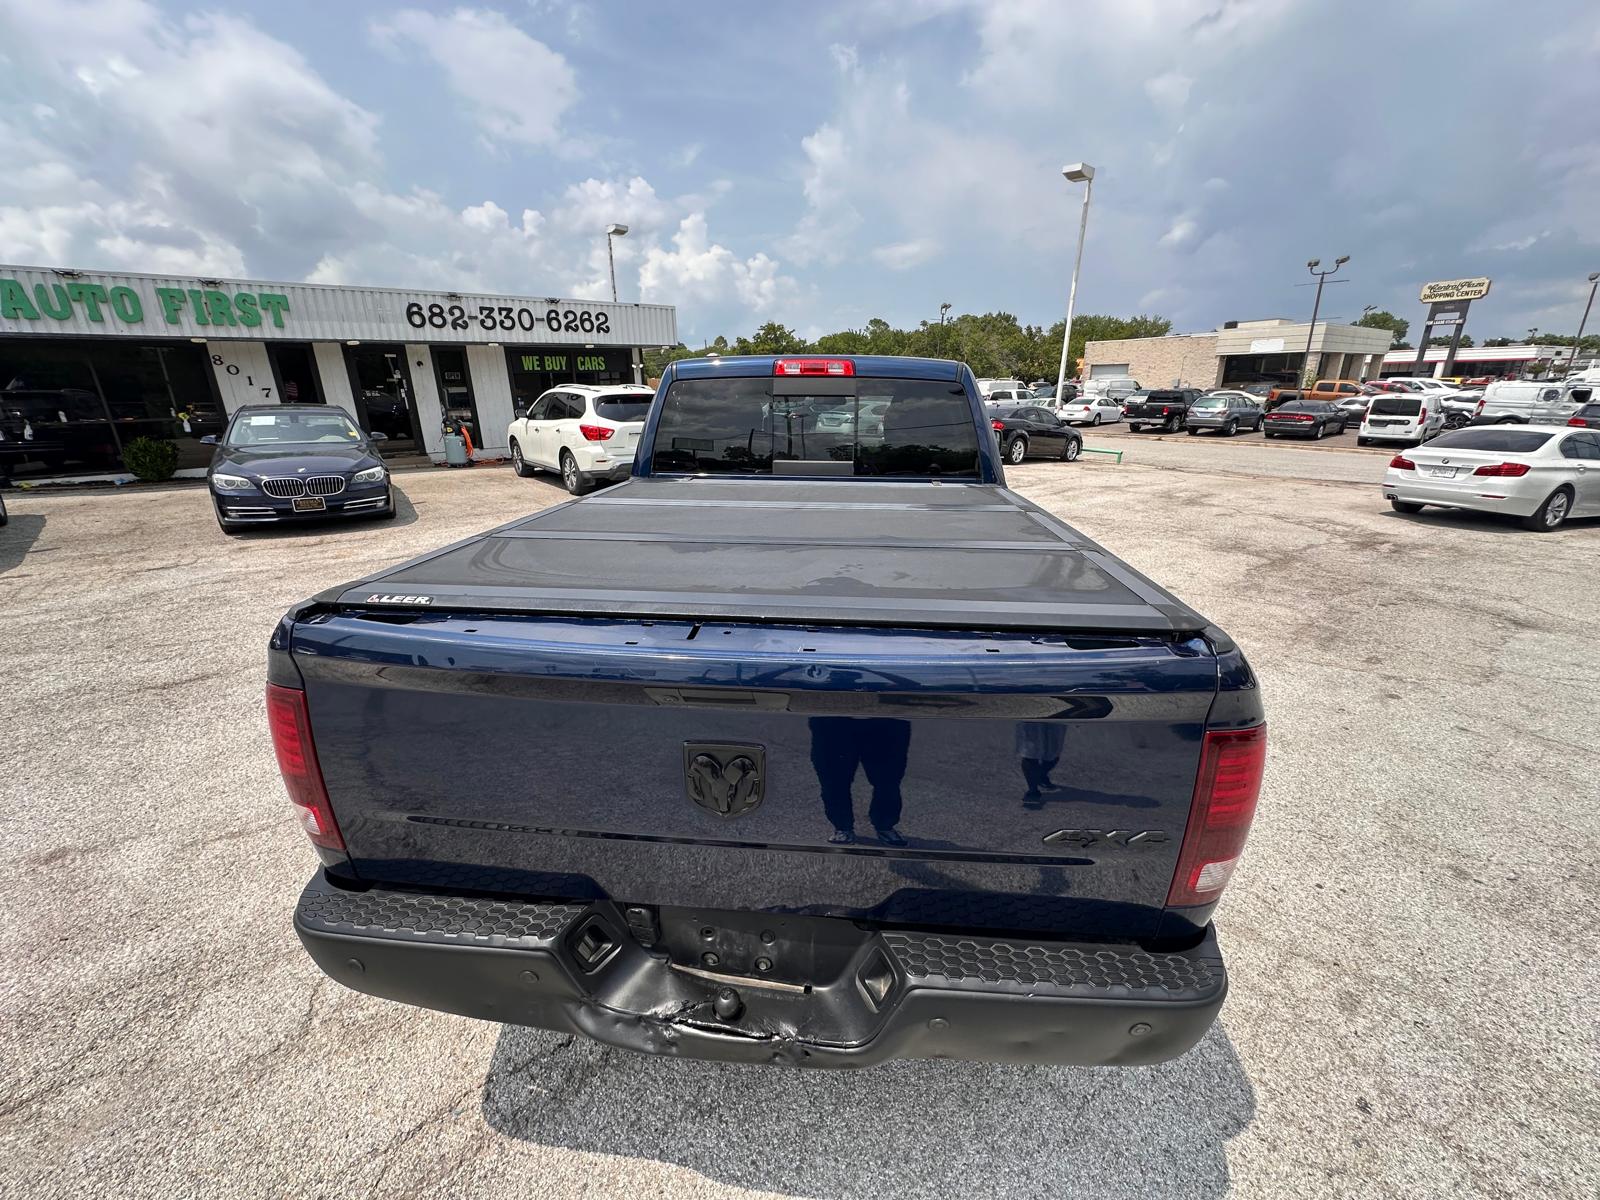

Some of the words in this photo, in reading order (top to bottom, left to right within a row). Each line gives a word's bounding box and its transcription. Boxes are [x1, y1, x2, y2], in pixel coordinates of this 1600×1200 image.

[1428, 283, 1460, 293] Central
[1423, 292, 1454, 300] SHOPPING
[0, 279, 144, 323] AUTO
[157, 288, 289, 328] FIRST
[406, 302, 610, 333] 682-330-6262
[521, 356, 540, 371] WE
[544, 356, 566, 371] BUY
[577, 356, 605, 371] CARS
[380, 595, 430, 604] LEER
